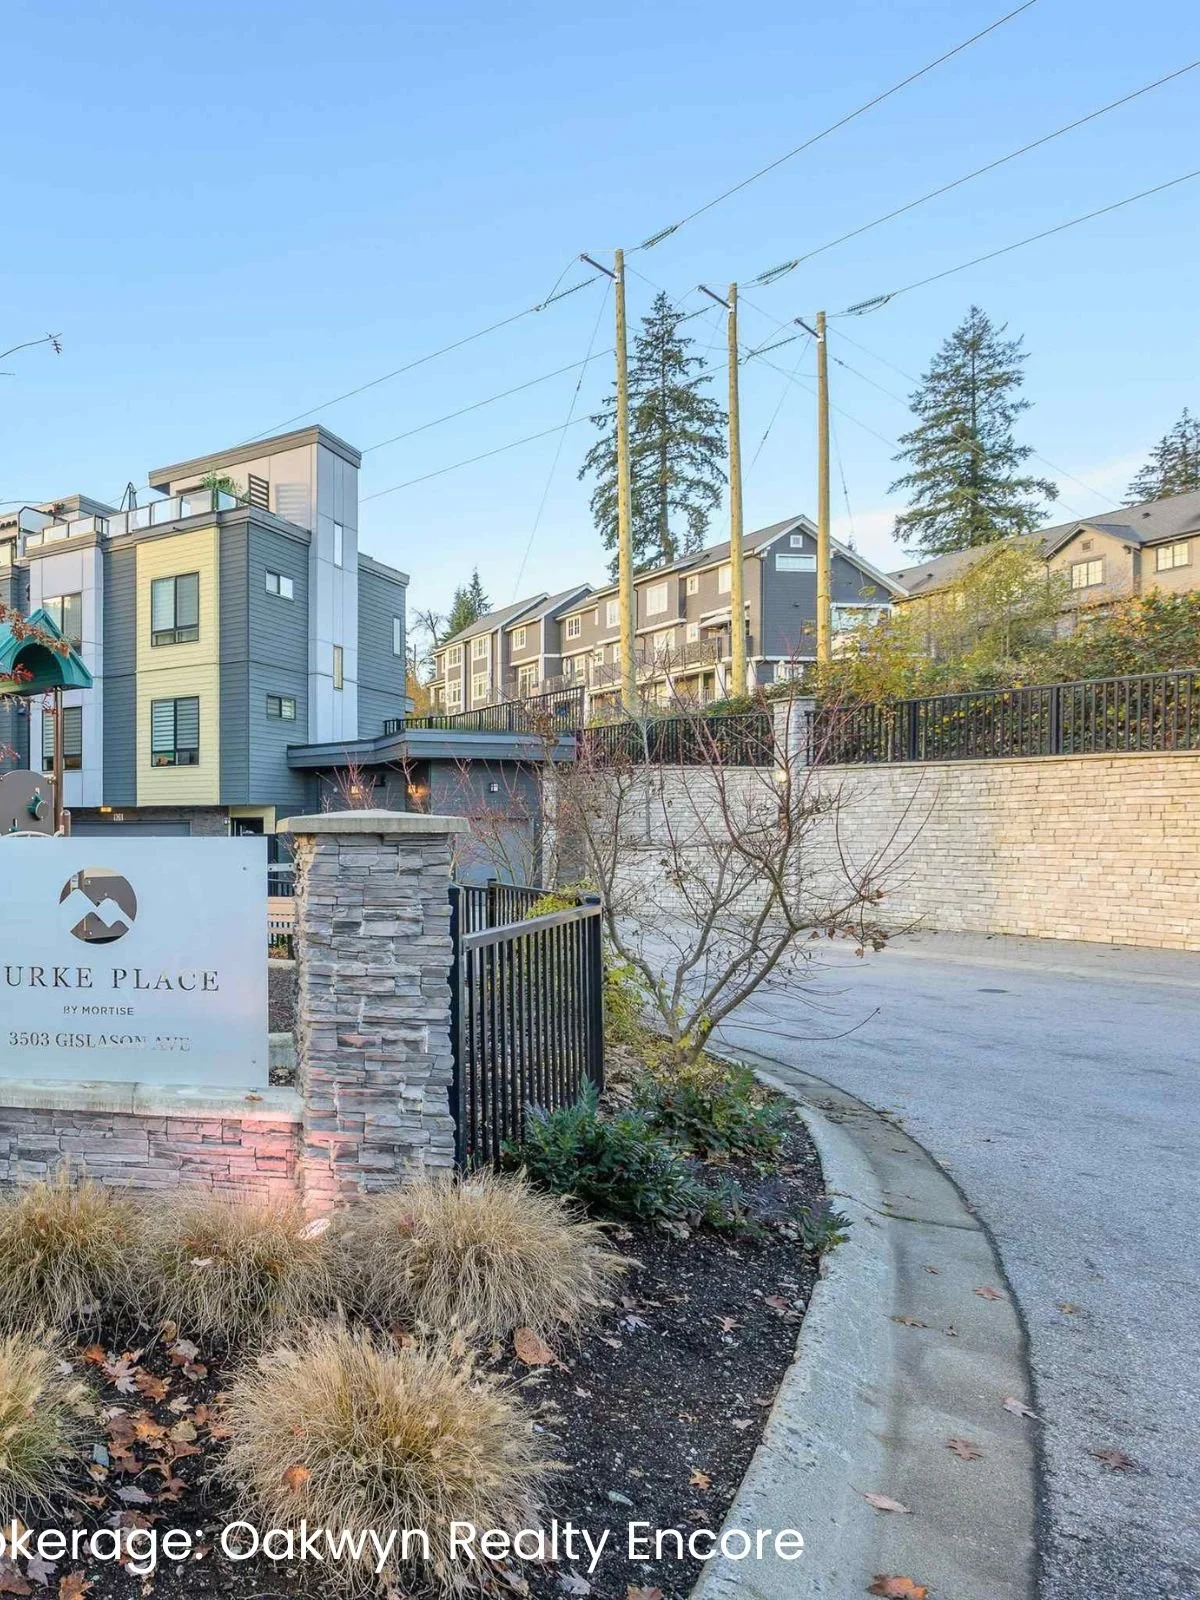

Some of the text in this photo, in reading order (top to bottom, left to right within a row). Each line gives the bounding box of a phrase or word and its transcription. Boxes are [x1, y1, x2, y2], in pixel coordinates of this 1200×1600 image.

[111, 968, 220, 991] PLACE
[63, 1005, 135, 1016] BY MORTISE
[8, 1031, 50, 1047] 3503
